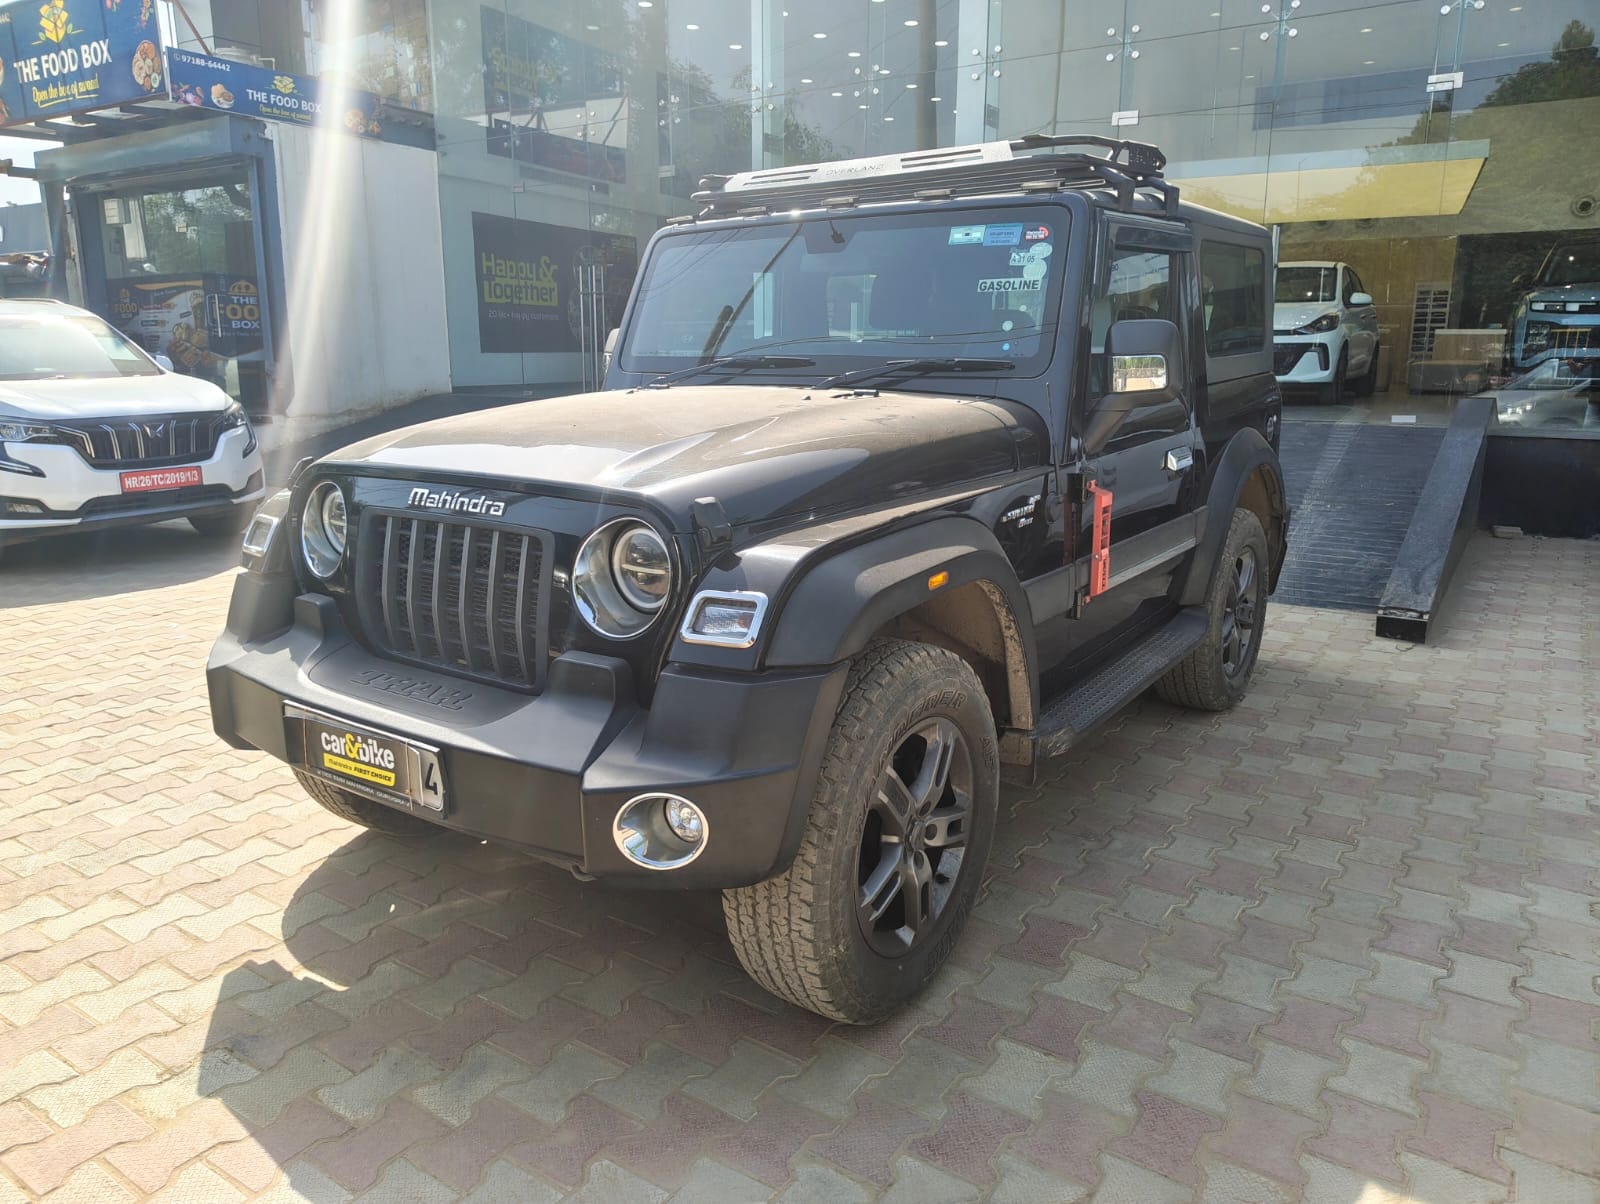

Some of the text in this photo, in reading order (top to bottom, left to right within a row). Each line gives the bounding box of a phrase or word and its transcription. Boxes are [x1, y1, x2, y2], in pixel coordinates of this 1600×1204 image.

[13, 39, 112, 83] THE FOOD BOX
[32, 86, 49, 105] Open
[49, 82, 58, 98] the
[246, 89, 322, 113] THE FOOD BOX
[481, 251, 560, 282] Happy &
[487, 279, 556, 303] Together
[979, 279, 1040, 292] GASOLINE
[231, 296, 258, 305] THE
[231, 320, 261, 329] BOX
[408, 487, 505, 516] Mahindra
[350, 670, 473, 711] THAR
[353, 766, 370, 777] FIRST
[371, 771, 392, 783] CHOICE
